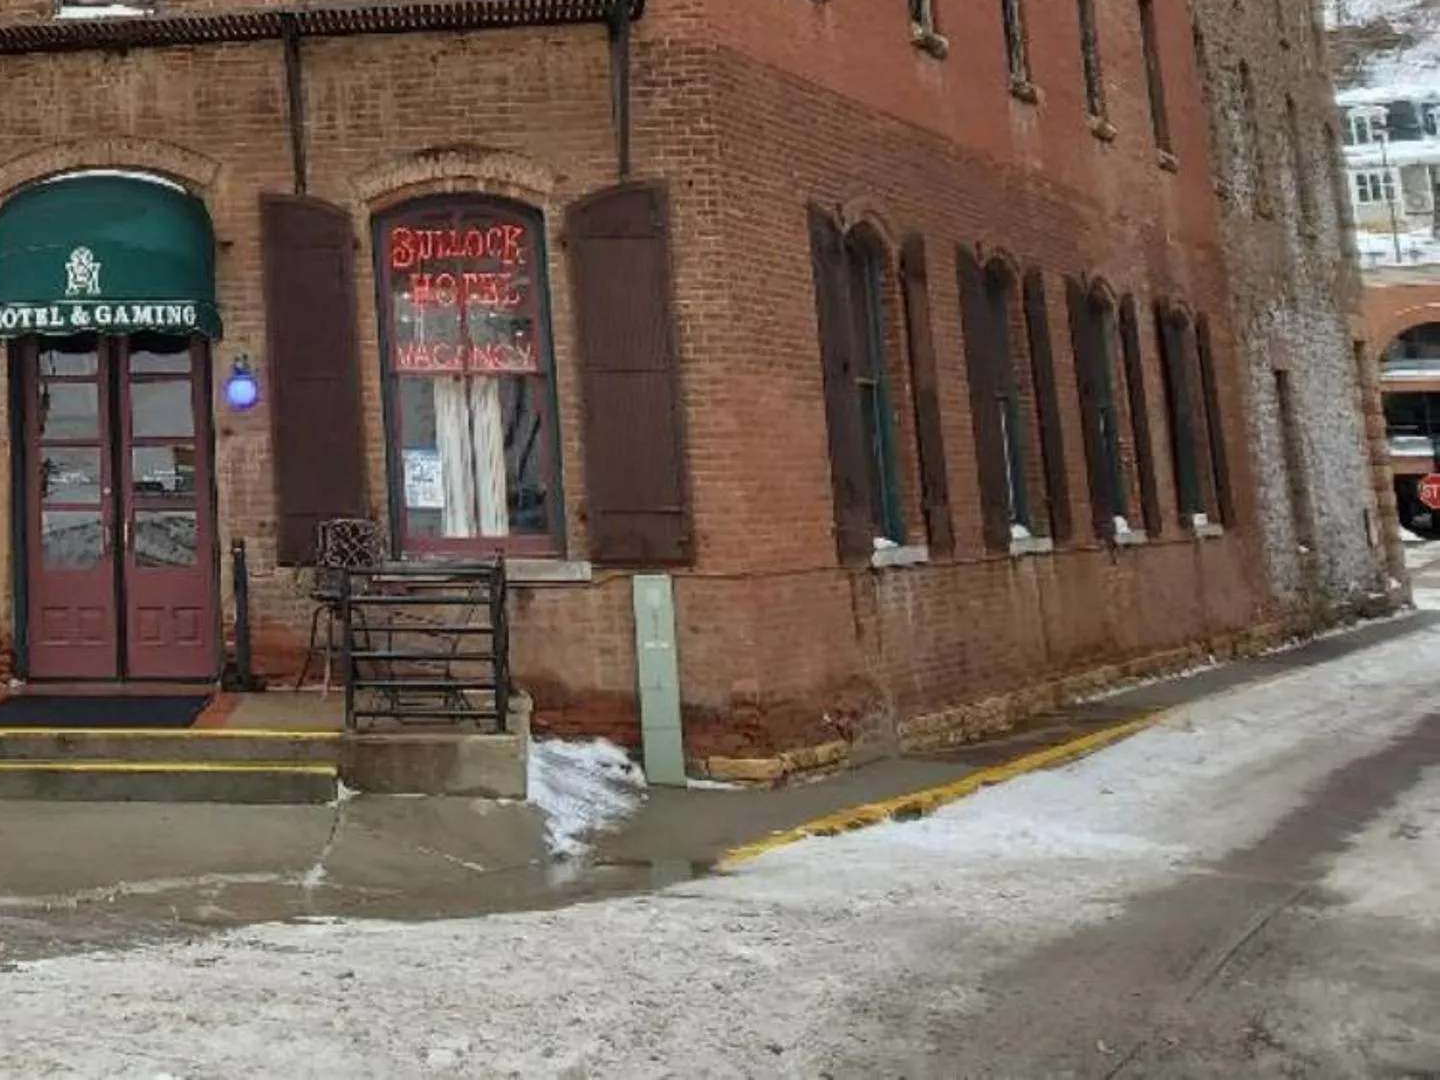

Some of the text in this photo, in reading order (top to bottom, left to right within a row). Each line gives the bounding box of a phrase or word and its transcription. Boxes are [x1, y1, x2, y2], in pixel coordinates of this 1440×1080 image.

[391, 224, 527, 268] BULLOCK
[409, 272, 521, 308] HOTEL
[70, 305, 91, 326] &
[94, 304, 198, 326] GAMING
